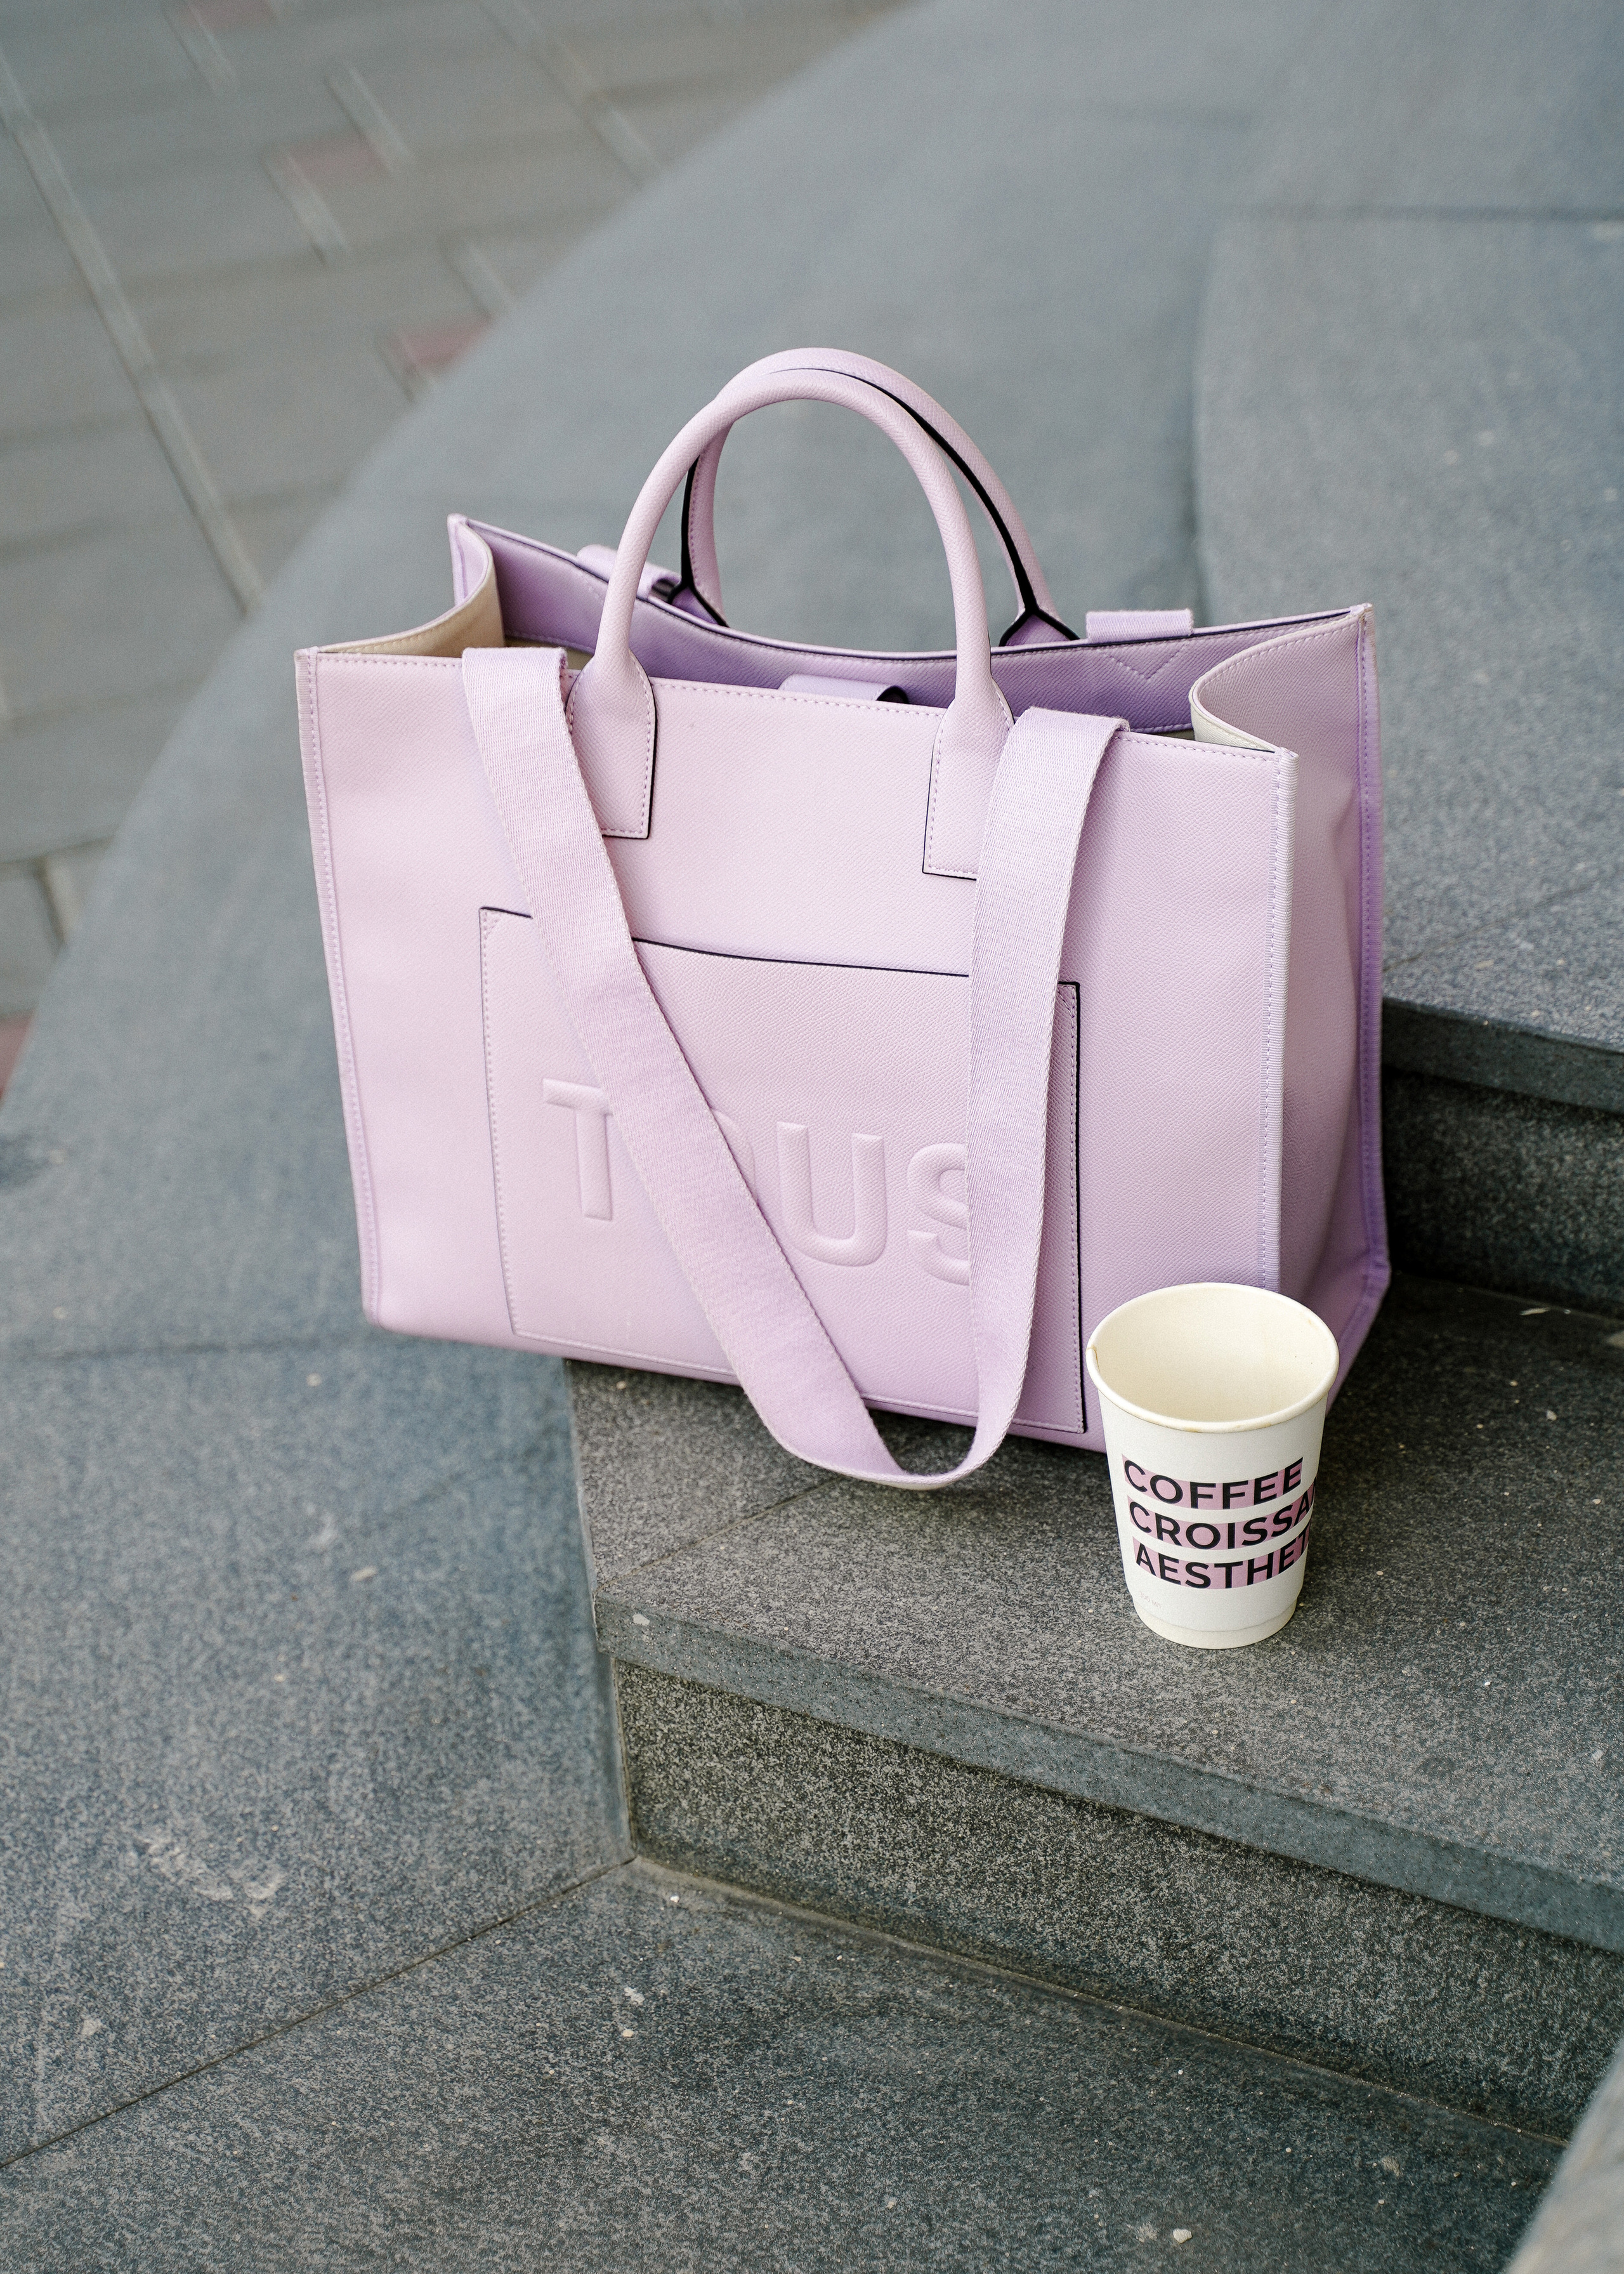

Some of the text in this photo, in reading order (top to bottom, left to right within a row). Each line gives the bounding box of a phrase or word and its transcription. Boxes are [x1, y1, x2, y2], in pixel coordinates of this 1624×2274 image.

[542, 1078, 971, 1286] TUS
[1123, 1457, 1304, 1510] COFFEE
[1129, 1476, 1316, 1549] CROISSA
